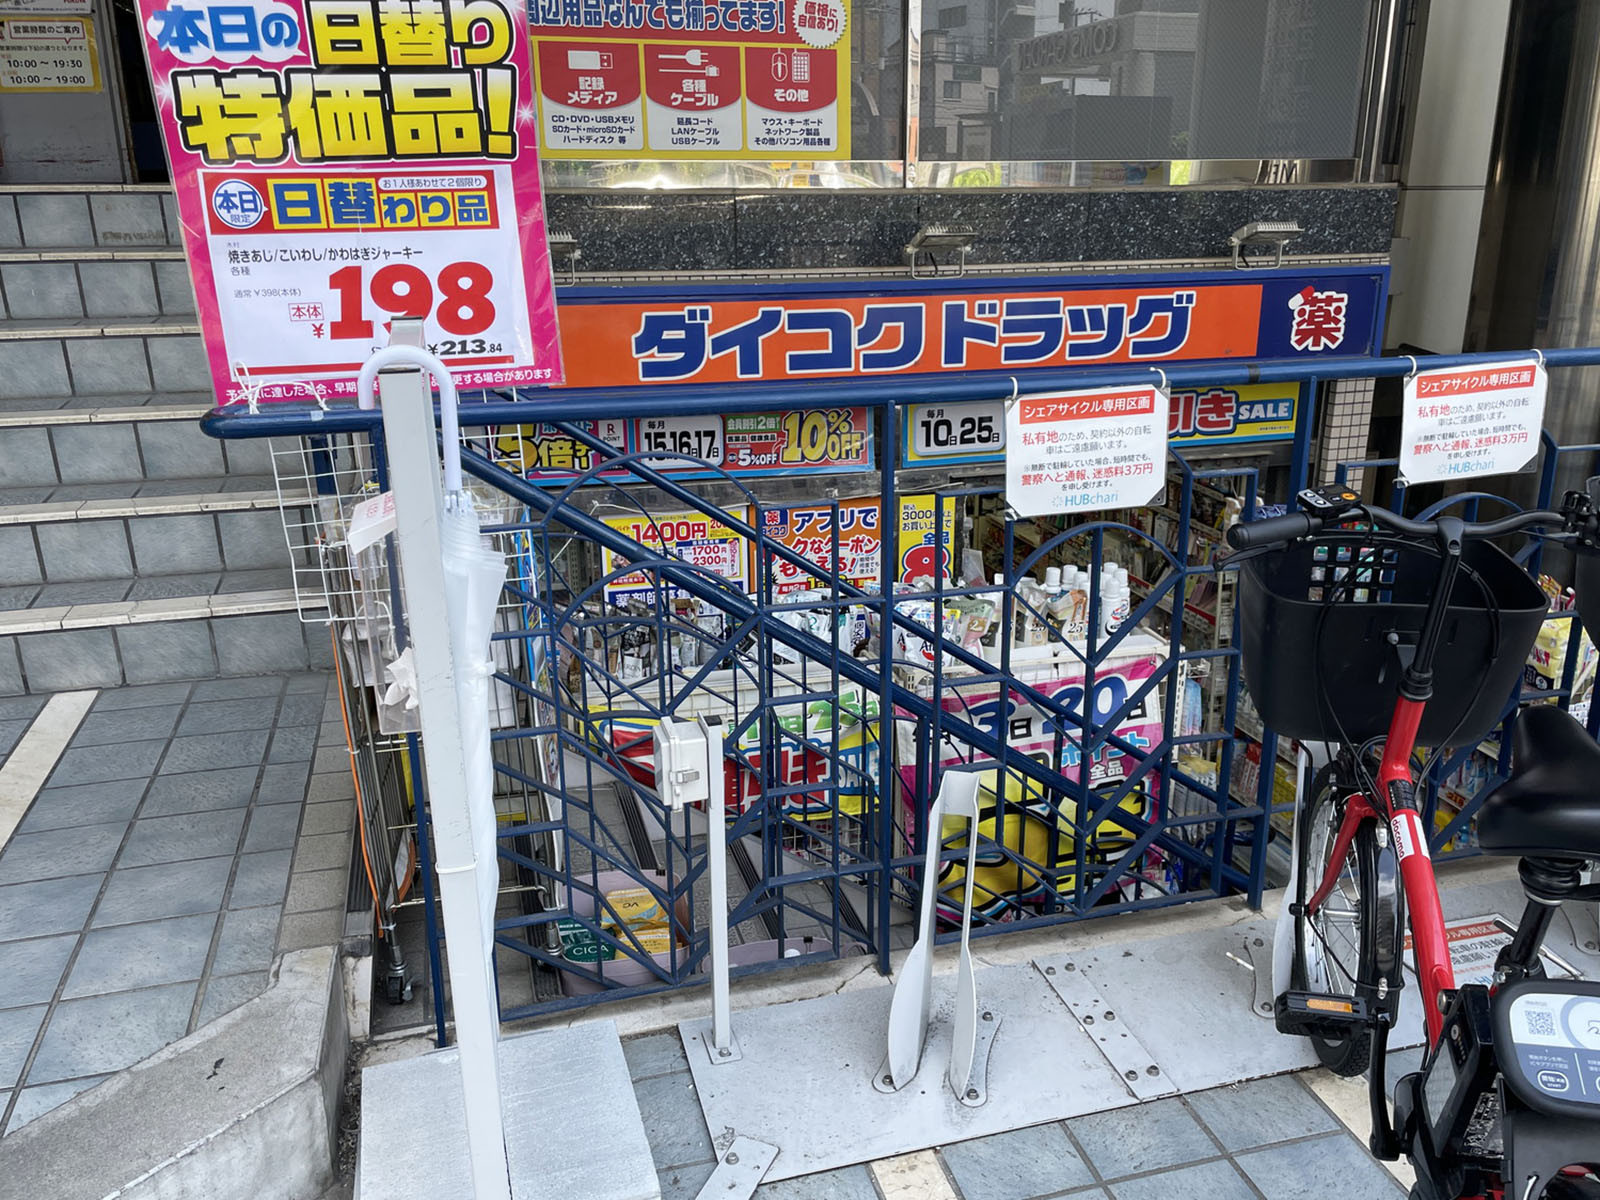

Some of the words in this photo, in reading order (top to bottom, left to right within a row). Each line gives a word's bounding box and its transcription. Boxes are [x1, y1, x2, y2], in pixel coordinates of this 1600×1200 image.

[805, 1, 837, 17] 価格に
[13, 25, 80, 34] 営業時間のご案内
[153, 4, 298, 53] 本日の
[798, 14, 838, 32] 自信あり!
[308, 0, 513, 67] 日替り
[7, 60, 37, 68] 10:00
[53, 60, 83, 68] 19:30
[10, 76, 40, 84] 10:00
[56, 76, 86, 84] 19:00
[578, 77, 604, 91] 記録
[682, 79, 707, 92] 各種
[568, 90, 618, 104] メディア
[671, 93, 718, 107] ケーブル
[774, 89, 809, 103] その他
[173, 70, 517, 160] 特価品!
[551, 114, 635, 124] CD・DVD・USBメモリ
[676, 117, 714, 126] 延長コード
[761, 117, 823, 127] マウス・キーボード
[552, 125, 636, 135] SDカード・microSDカード
[671, 127, 720, 136] LANケーブル
[764, 127, 820, 137] ネットワーク製品
[563, 135, 615, 145] ハードディスク
[618, 135, 626, 145] 等
[671, 137, 720, 146] USBケーブル
[754, 137, 831, 147] その他パソコン用品各種
[383, 177, 482, 190] お1人様あわせて2個限り
[216, 190, 260, 214] 本日
[273, 180, 489, 225] 日替わり品
[230, 214, 251, 223] 限定
[228, 246, 423, 264] 焼きあじ/こいわし/かわはぎジャーキー
[230, 266, 251, 276] 各種
[234, 289, 252, 298] 通常
[291, 304, 322, 319] 本体
[1288, 287, 1348, 352] 薬
[1421, 371, 1531, 393] シェアサイクル専用区画
[927, 409, 944, 418] 毎月
[1025, 397, 1150, 418] シェアサイクル専用区画
[1239, 402, 1290, 420] SALE
[647, 420, 665, 430] 毎月
[1022, 425, 1151, 446] 私有地のため、契約以外の自転
[1046, 441, 1128, 454] 車はご遠慮願います。
[1021, 463, 1153, 486] 警察へと通報、迷惑料3万円
[1448, 461, 1495, 475] HUBchari
[1061, 480, 1113, 491] を申し受けます。
[1065, 492, 1118, 507] HUBchari
[631, 521, 706, 543] 1400円
[692, 545, 727, 555] 1700円
[1090, 761, 1124, 780] 全品
[1392, 819, 1405, 858] docomo
[573, 944, 609, 956] CICA
